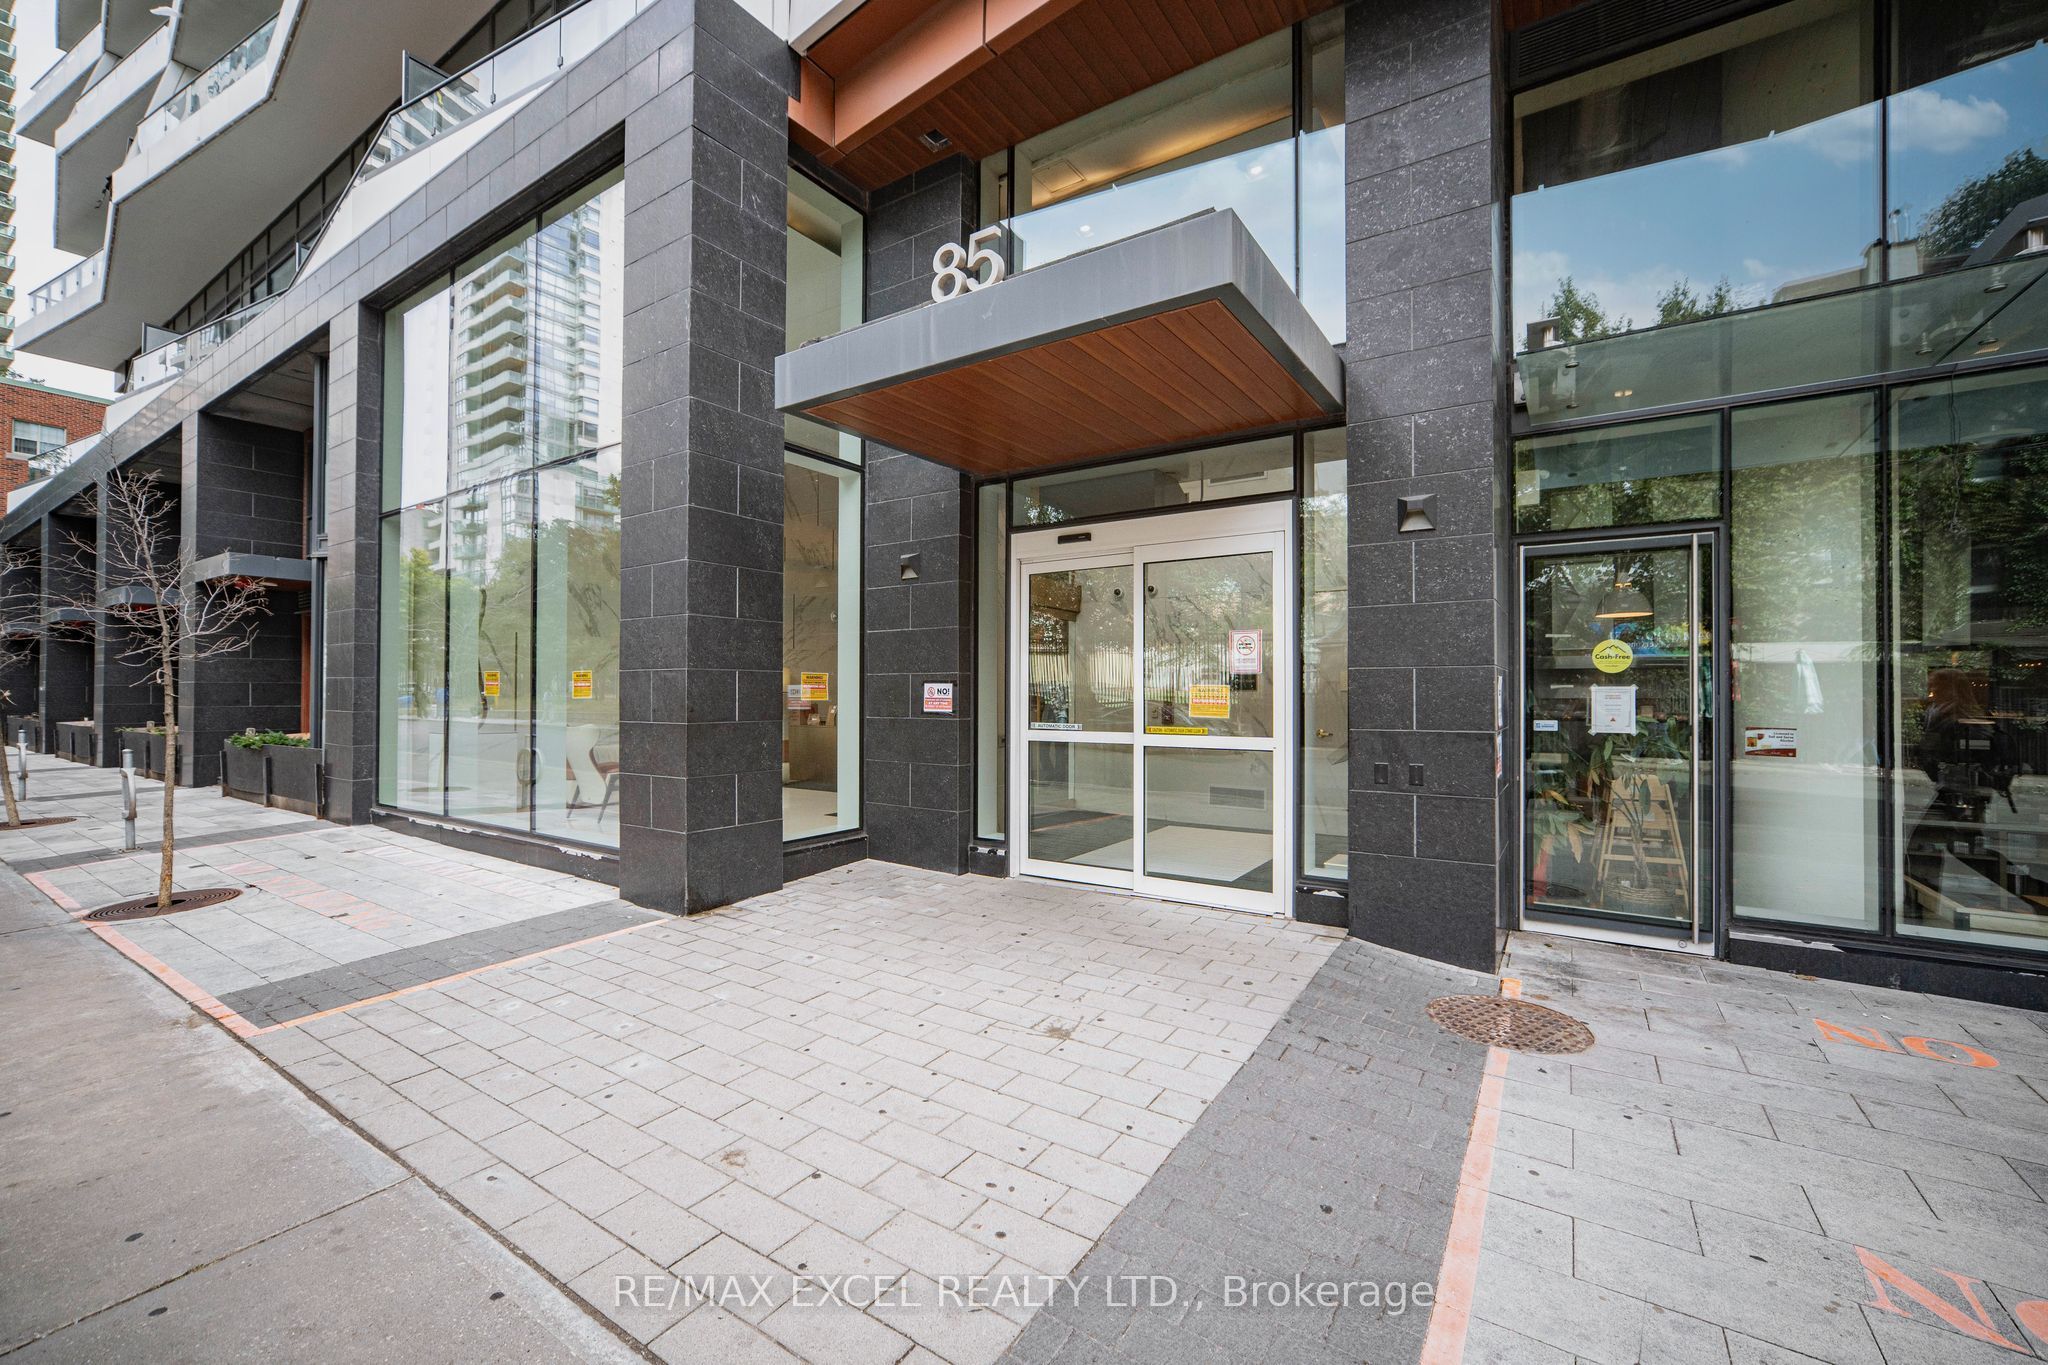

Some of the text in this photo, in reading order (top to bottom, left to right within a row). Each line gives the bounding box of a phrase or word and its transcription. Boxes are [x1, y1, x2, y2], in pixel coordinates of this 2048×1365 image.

[931, 225, 1005, 303] 85
[1814, 1018, 2000, 1069] NO
[1854, 1244, 2048, 1355] N
